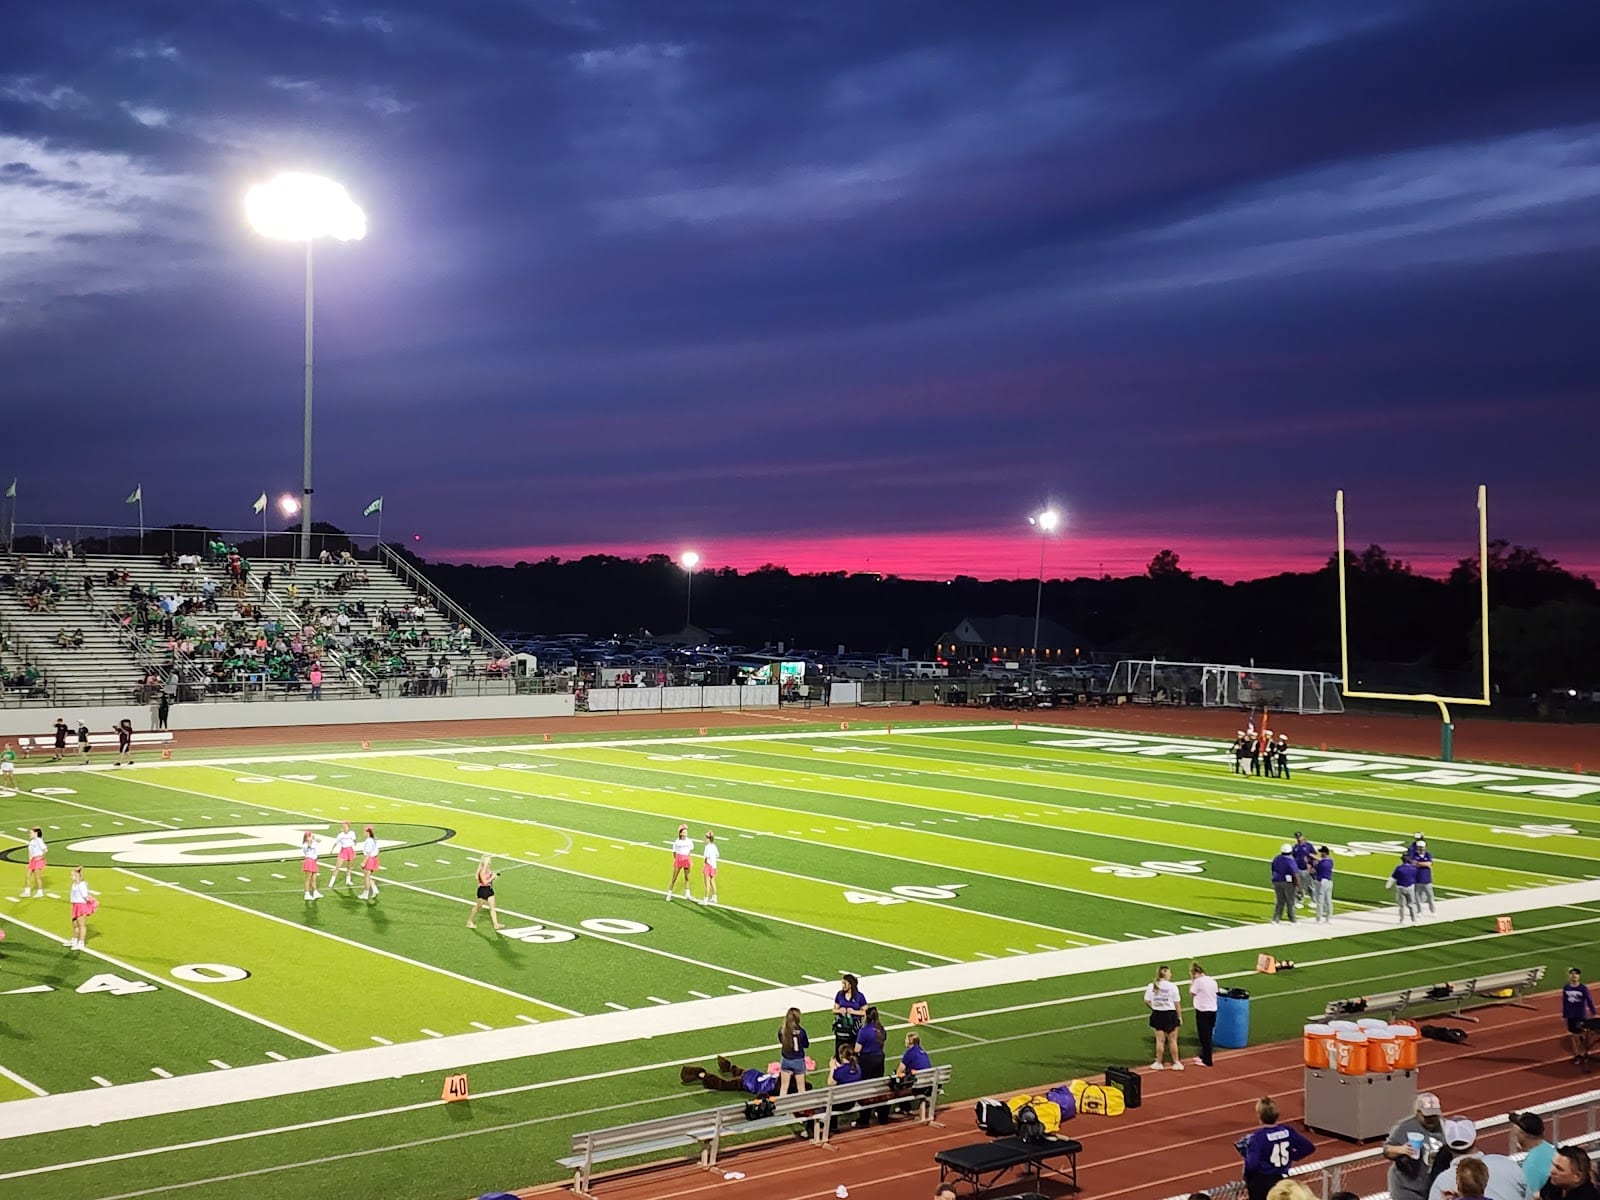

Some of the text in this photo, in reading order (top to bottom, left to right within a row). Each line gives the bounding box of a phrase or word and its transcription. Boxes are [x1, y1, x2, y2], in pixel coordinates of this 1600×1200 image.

[1091, 861, 1206, 878] 30
[843, 886, 960, 906] 40
[496, 918, 652, 943] 50
[74, 963, 251, 995] 40
[915, 1005, 928, 1023] 50
[448, 1077, 467, 1097] 40
[1269, 1141, 1290, 1167] 45
